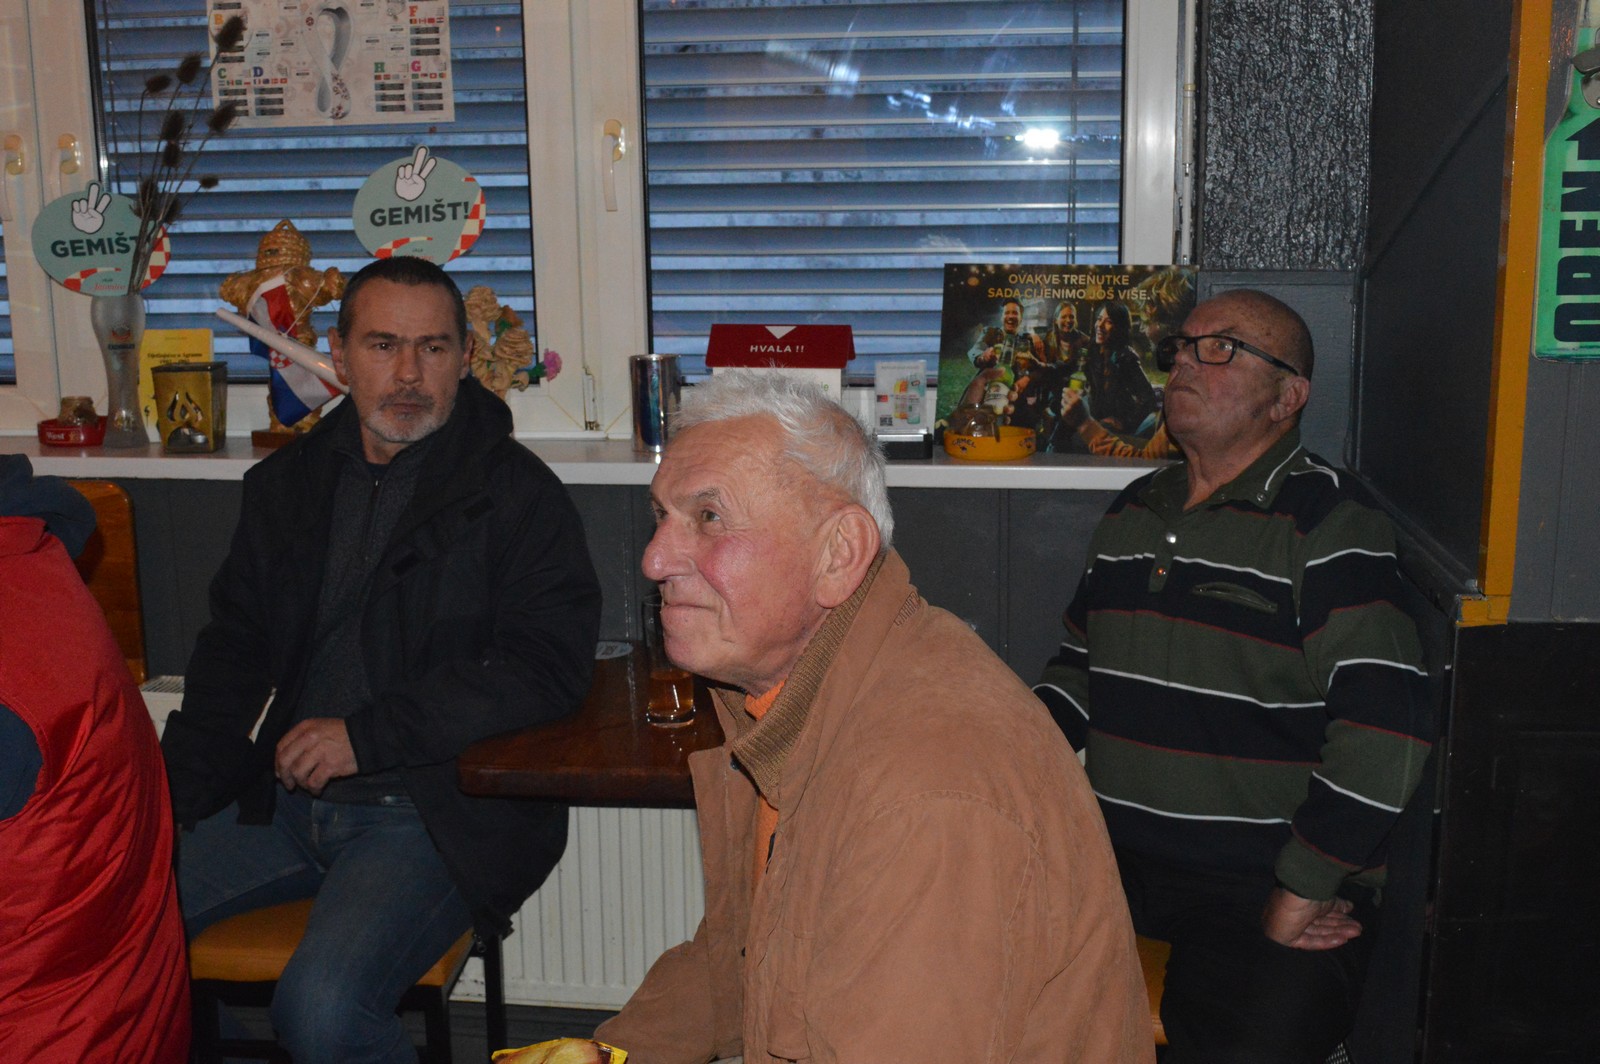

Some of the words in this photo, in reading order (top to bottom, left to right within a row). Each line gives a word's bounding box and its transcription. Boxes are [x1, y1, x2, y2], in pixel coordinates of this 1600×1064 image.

[253, 66, 264, 77] D
[374, 62, 385, 73] H
[411, 60, 422, 72] G
[217, 67, 227, 79] C
[369, 198, 470, 227] GEMIŠT!
[1008, 273, 1060, 285] OVAKVE
[1062, 273, 1130, 285] TRENUTKE
[987, 287, 1020, 298] SADA
[1024, 288, 1087, 299] CIJENIMO
[1088, 286, 1115, 300] JOŠ
[1117, 286, 1151, 300] VIŠE.
[750, 344, 792, 353] HVALA
